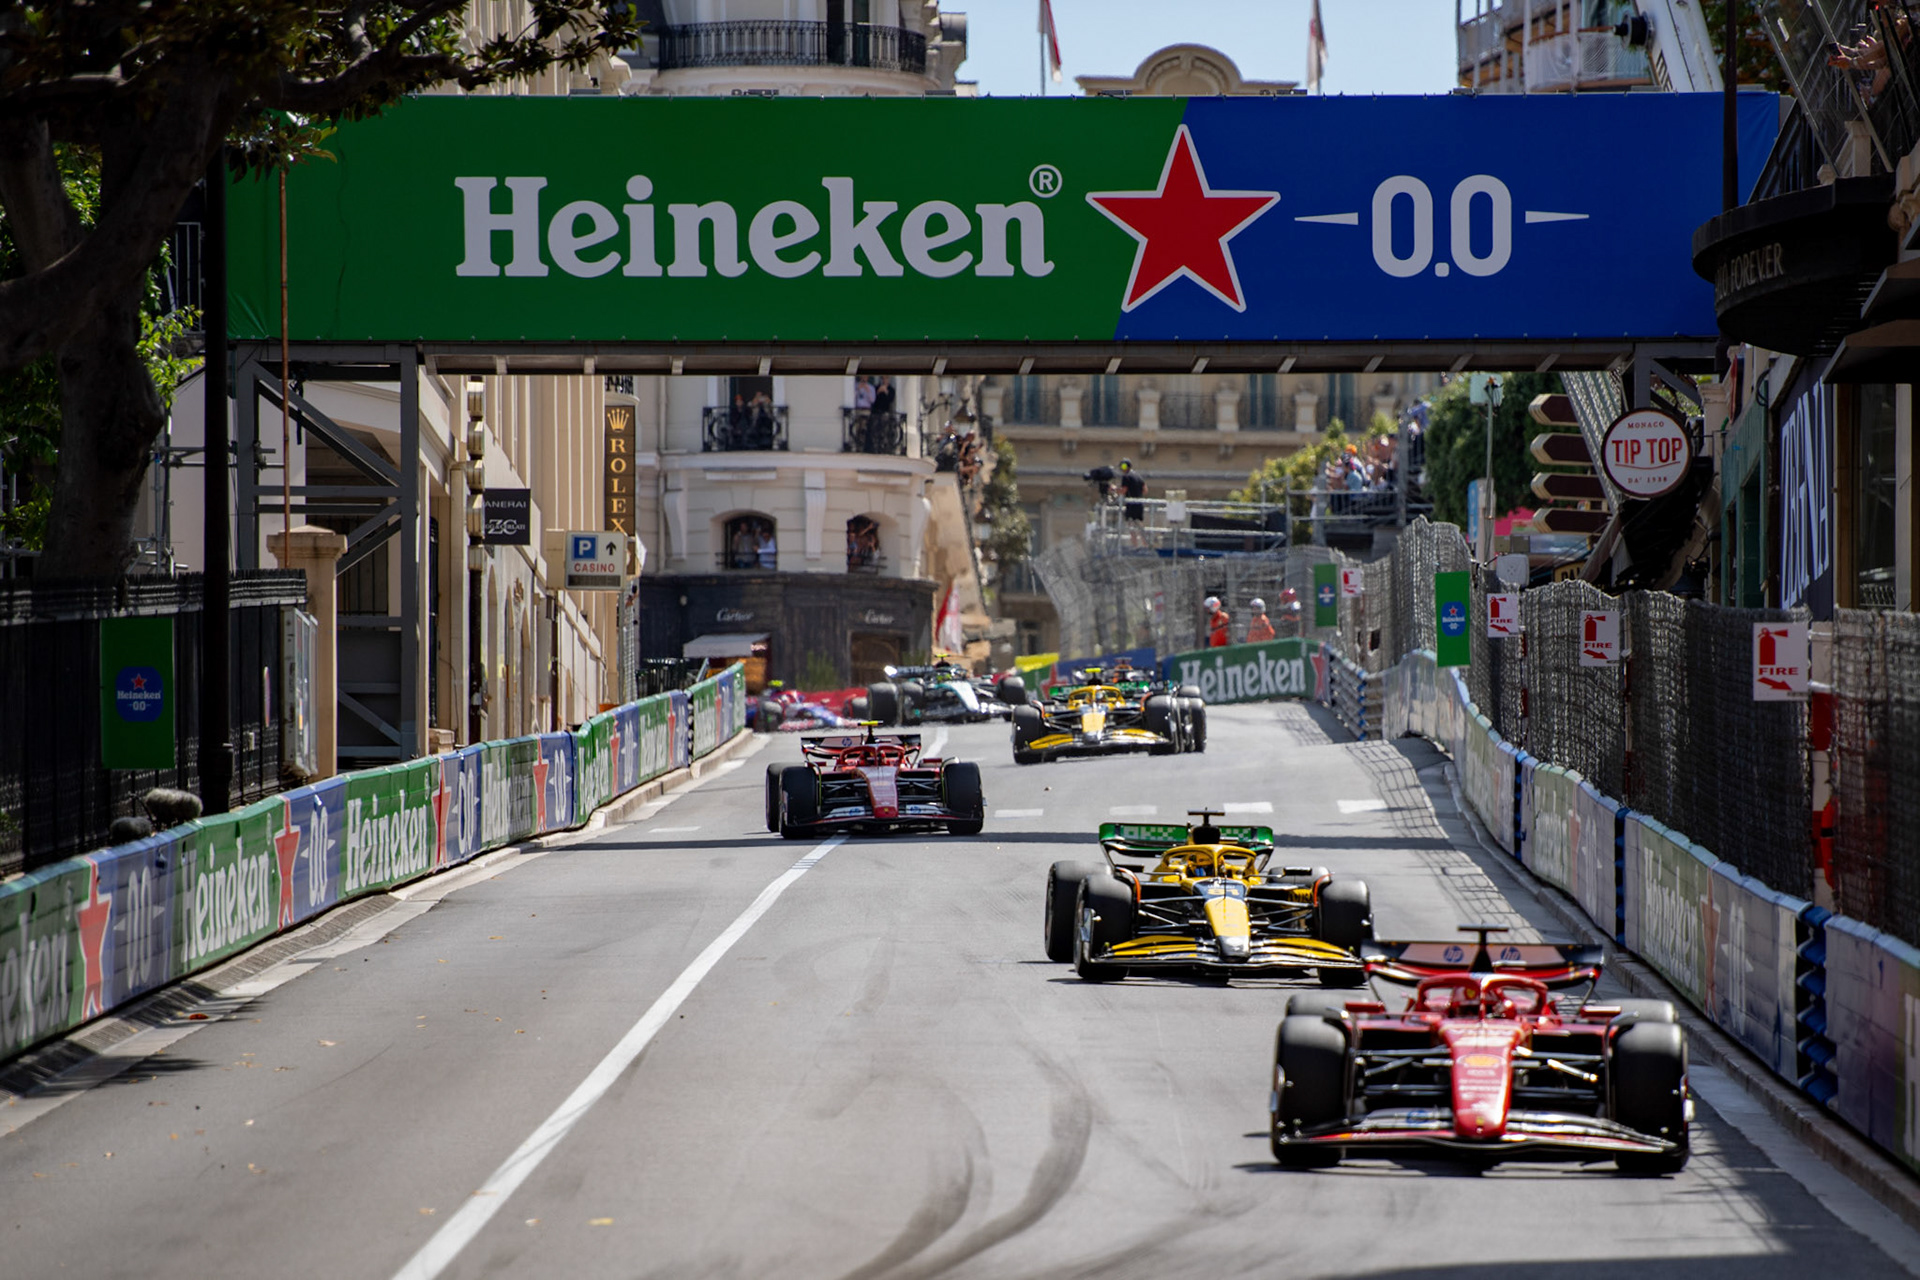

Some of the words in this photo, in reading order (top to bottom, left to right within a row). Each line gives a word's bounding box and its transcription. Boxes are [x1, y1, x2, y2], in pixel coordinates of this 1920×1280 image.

[454, 174, 1055, 278] Heineken
[1372, 174, 1512, 278] 0.0
[1731, 242, 1784, 293] FOREVER
[1628, 421, 1664, 429] MONACO
[1612, 439, 1641, 464] TIP
[1646, 437, 1682, 464] TOP
[484, 500, 527, 508] ANERAI
[610, 438, 627, 534] ROLEX
[1781, 376, 1830, 609] ZEGNA
[579, 540, 591, 555] P
[574, 563, 615, 573] CASINO
[1179, 651, 1306, 700] Heineken
[1758, 667, 1799, 676] FIRE
[117, 690, 161, 700] Heineken
[346, 788, 429, 892] Heineken
[182, 837, 270, 964] Heineken
